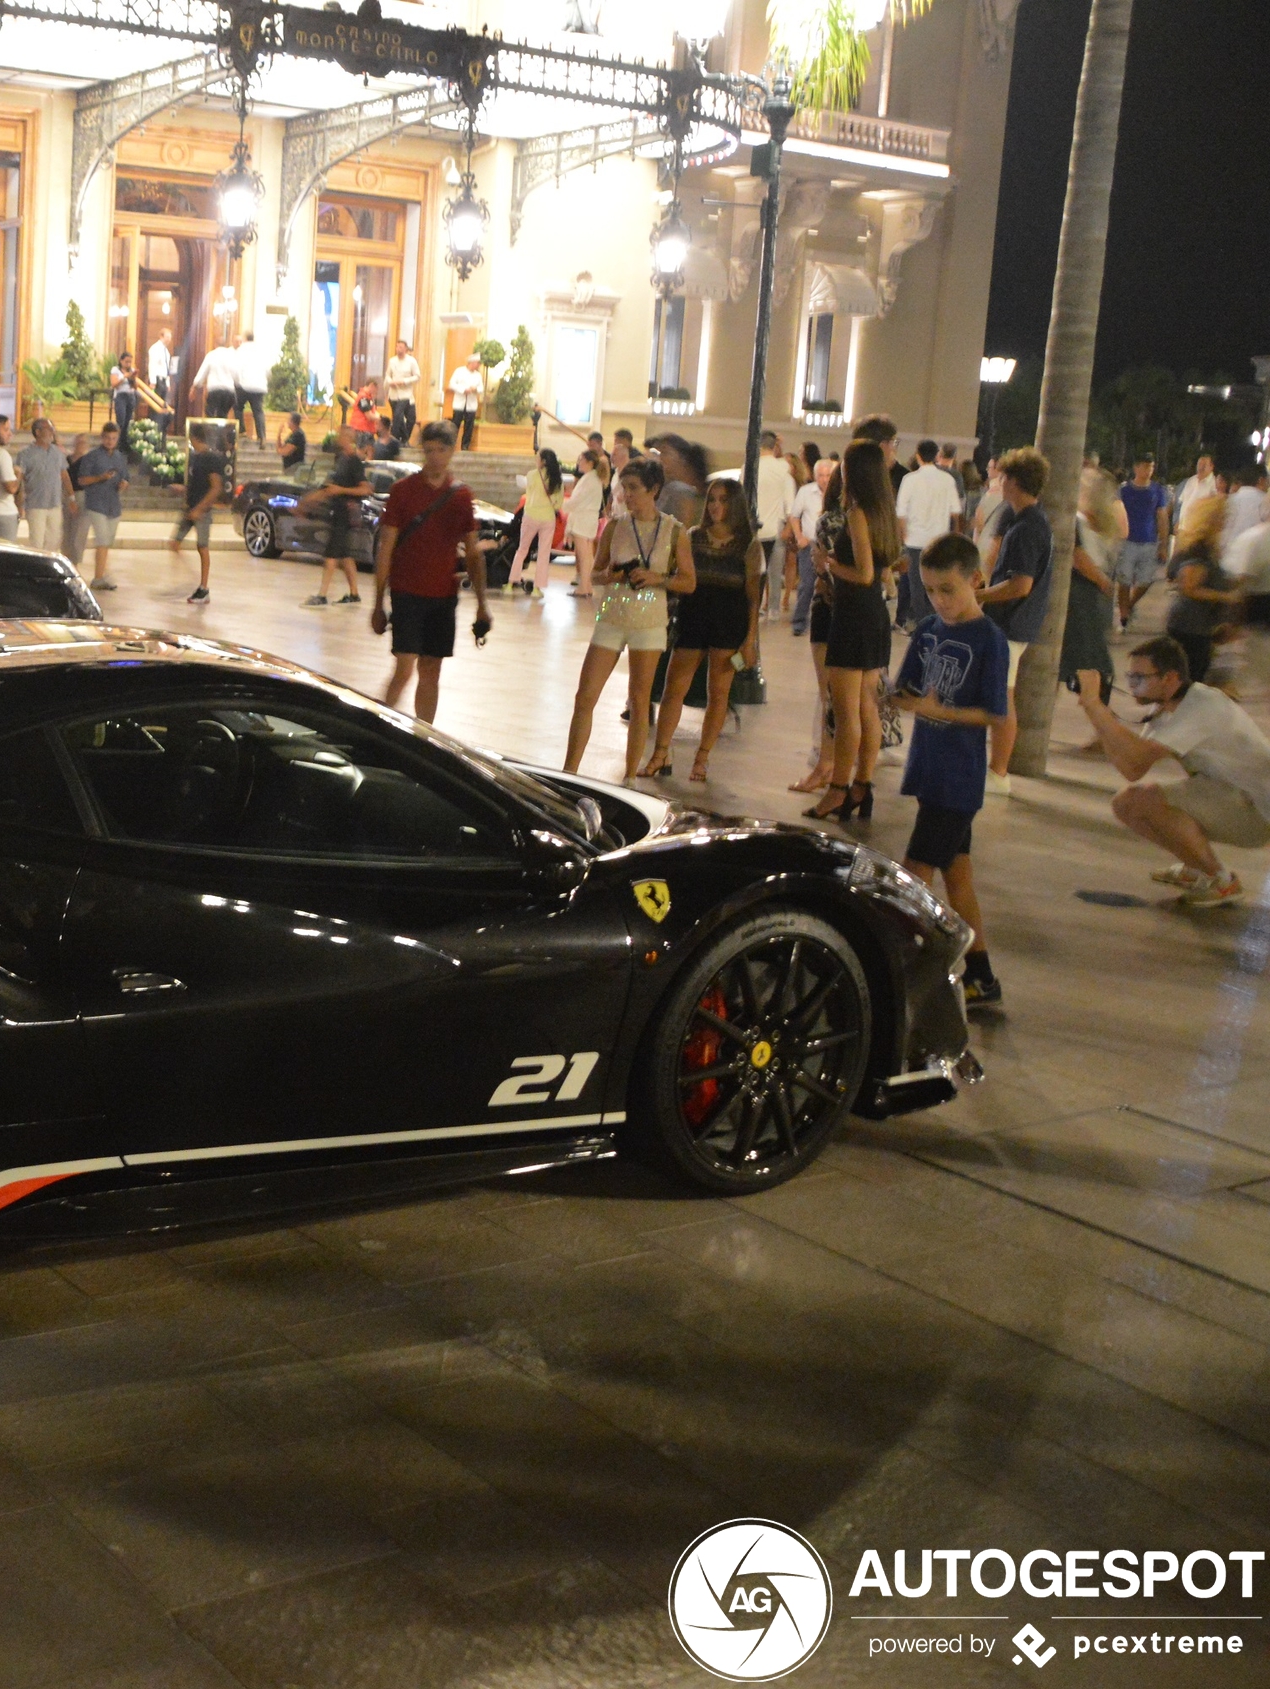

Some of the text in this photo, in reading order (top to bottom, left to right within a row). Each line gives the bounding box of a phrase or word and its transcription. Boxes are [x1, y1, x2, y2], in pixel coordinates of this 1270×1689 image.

[653, 400, 696, 416] GRAFF
[805, 412, 844, 427] GRAFF
[488, 1051, 600, 1107] 21
